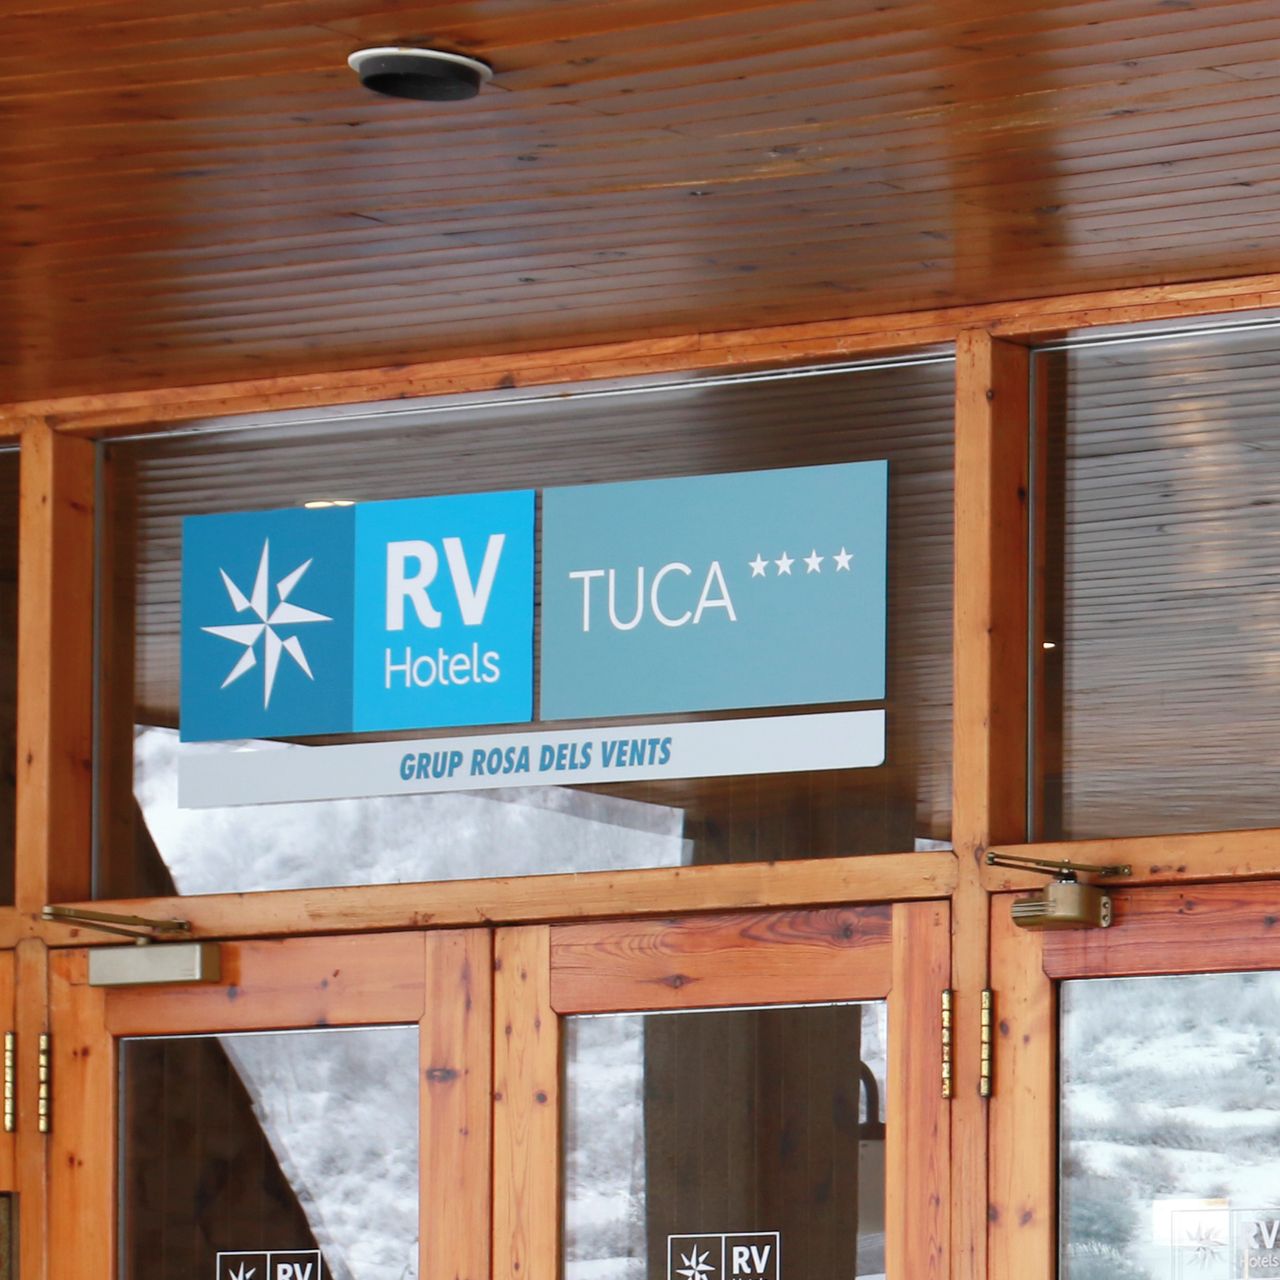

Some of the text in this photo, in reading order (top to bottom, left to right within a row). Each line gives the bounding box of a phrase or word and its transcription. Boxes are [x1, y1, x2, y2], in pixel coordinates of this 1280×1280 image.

[386, 533, 506, 631] RV
[569, 560, 737, 632] TUCA
[385, 642, 500, 689] Hotels
[399, 737, 672, 781] GRUP ROSA DELS VENTS
[732, 1245, 771, 1274] RV
